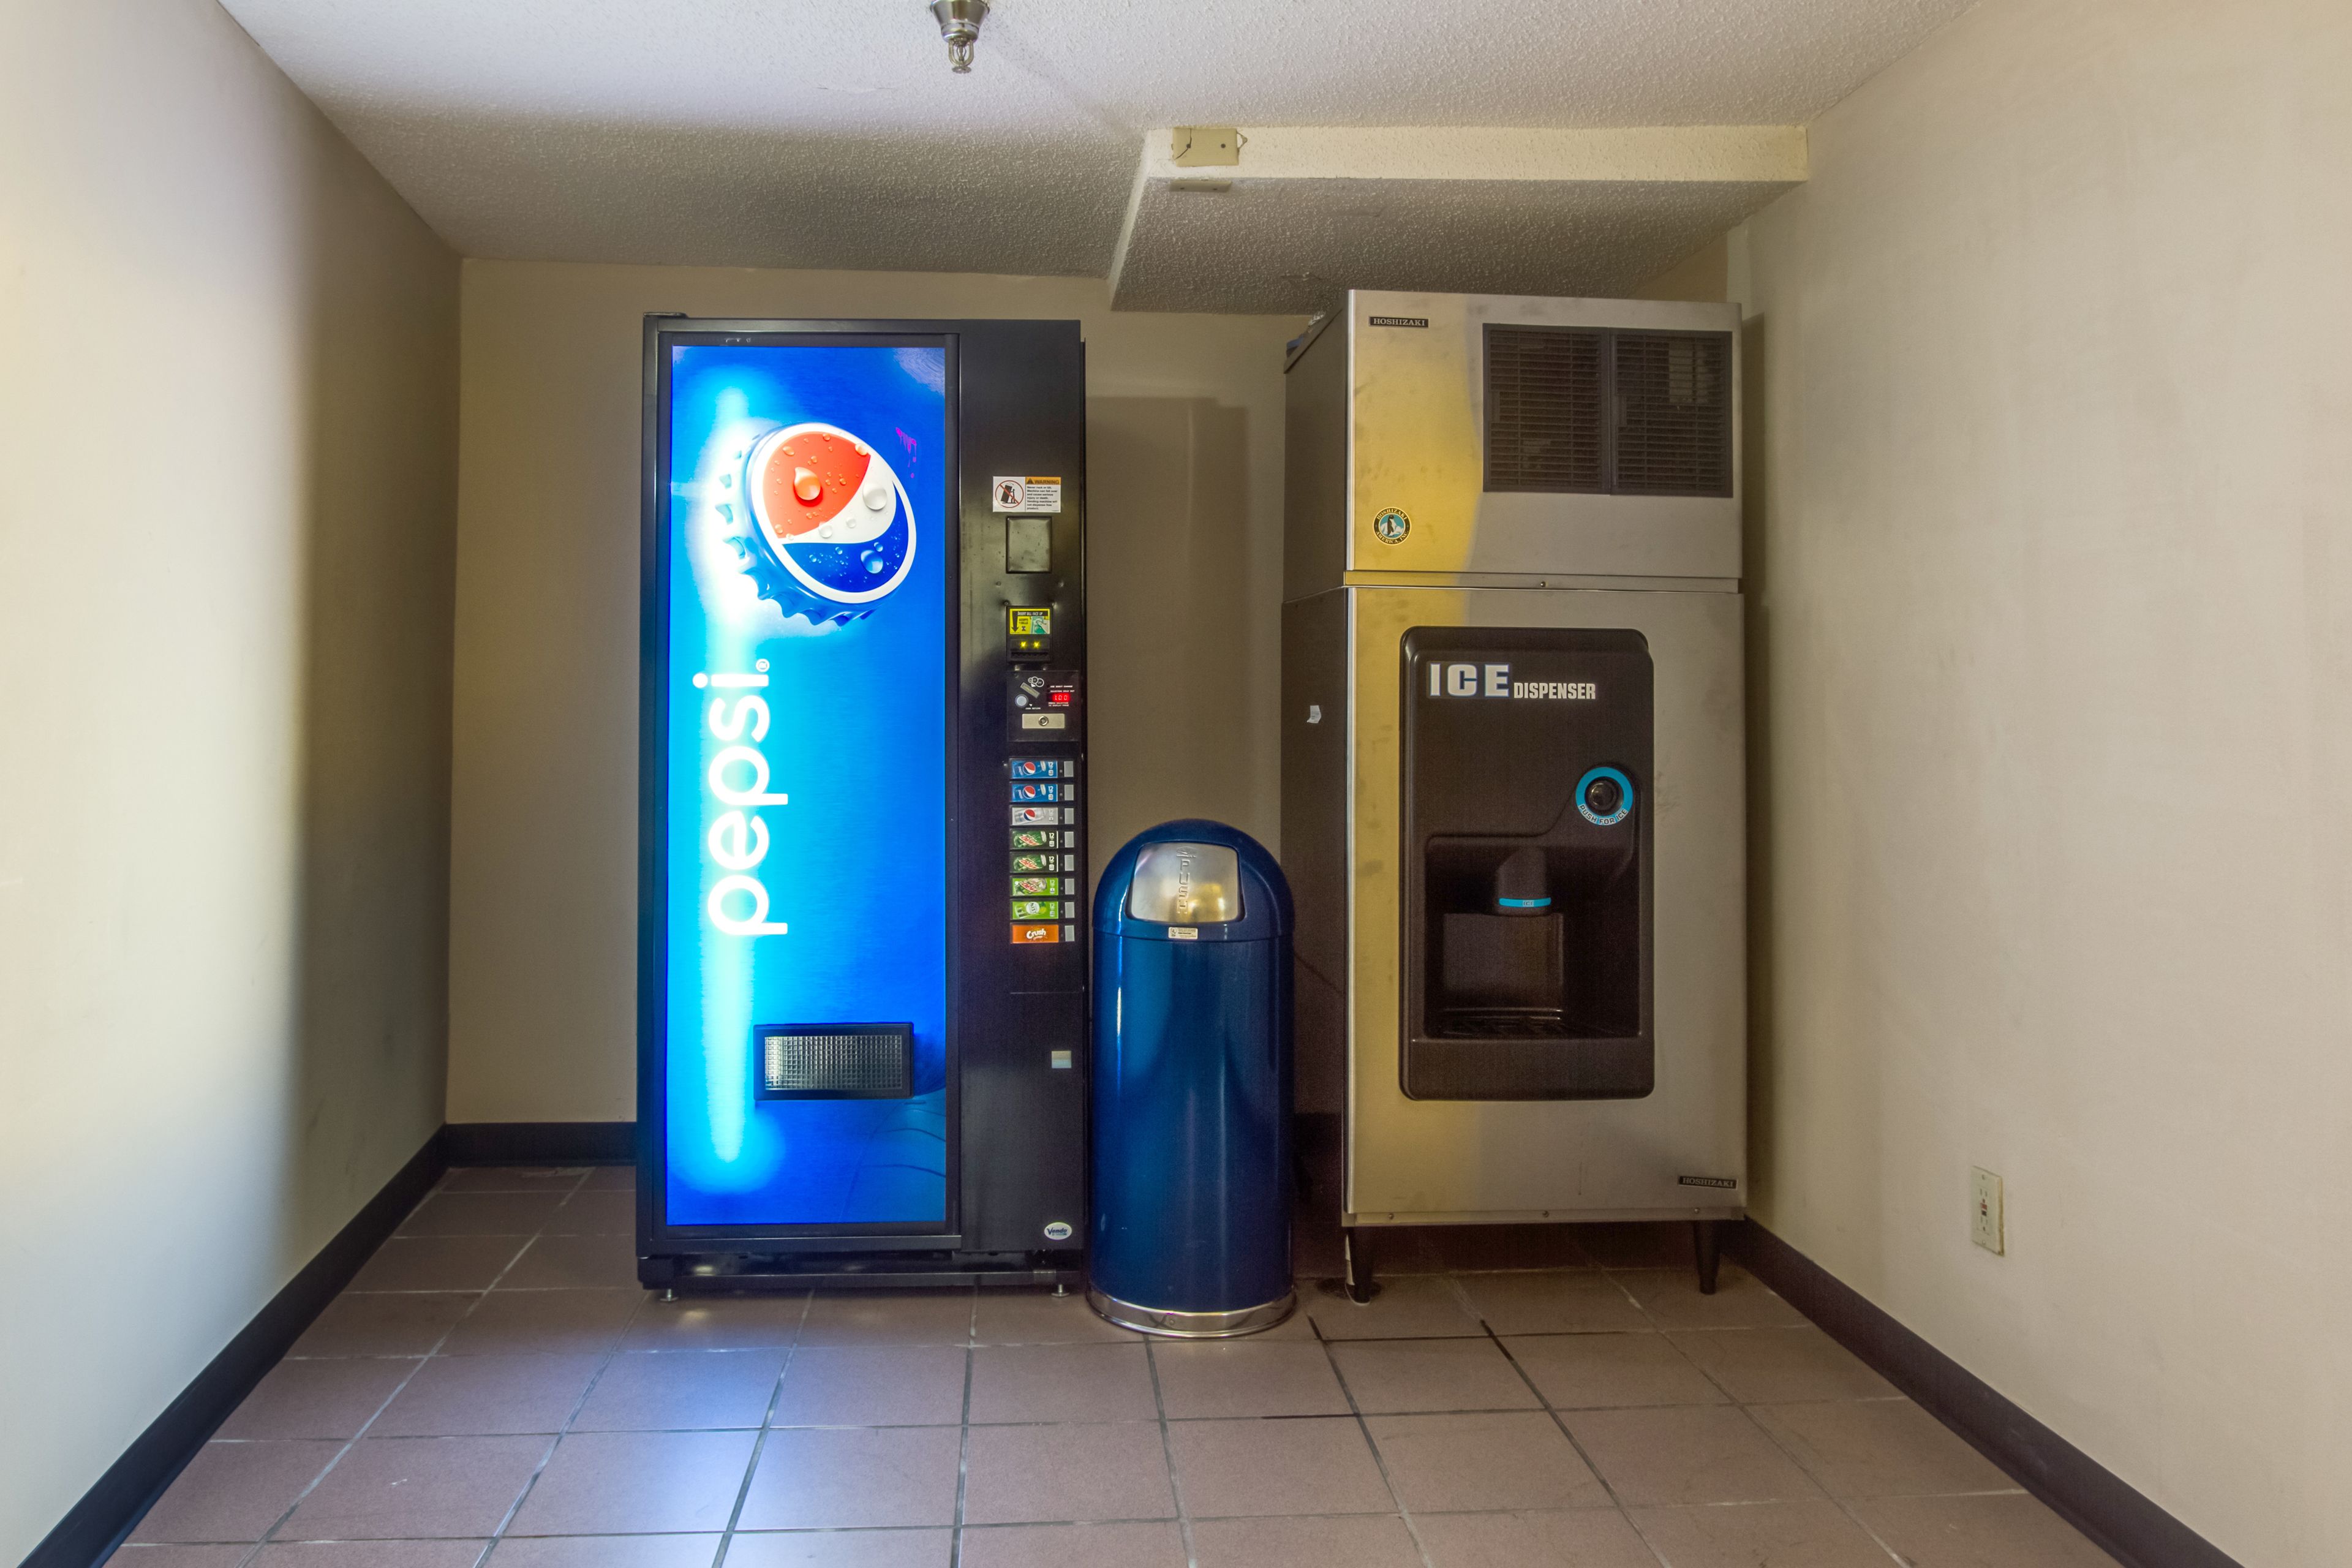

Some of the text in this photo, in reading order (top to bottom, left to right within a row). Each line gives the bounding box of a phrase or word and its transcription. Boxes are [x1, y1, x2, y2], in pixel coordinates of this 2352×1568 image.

[1374, 318, 1425, 326] HOSHIZAKI
[1376, 508, 1408, 520] HOSHIZAKI
[1430, 663, 1596, 699] ICE DISPENSER
[1579, 804, 1597, 823] PUSH
[1616, 809, 1627, 820] ICE
[1176, 859, 1191, 914] PUSH
[1027, 928, 1046, 939] Crush
[1683, 1177, 1734, 1188] HOSHIZAKI
